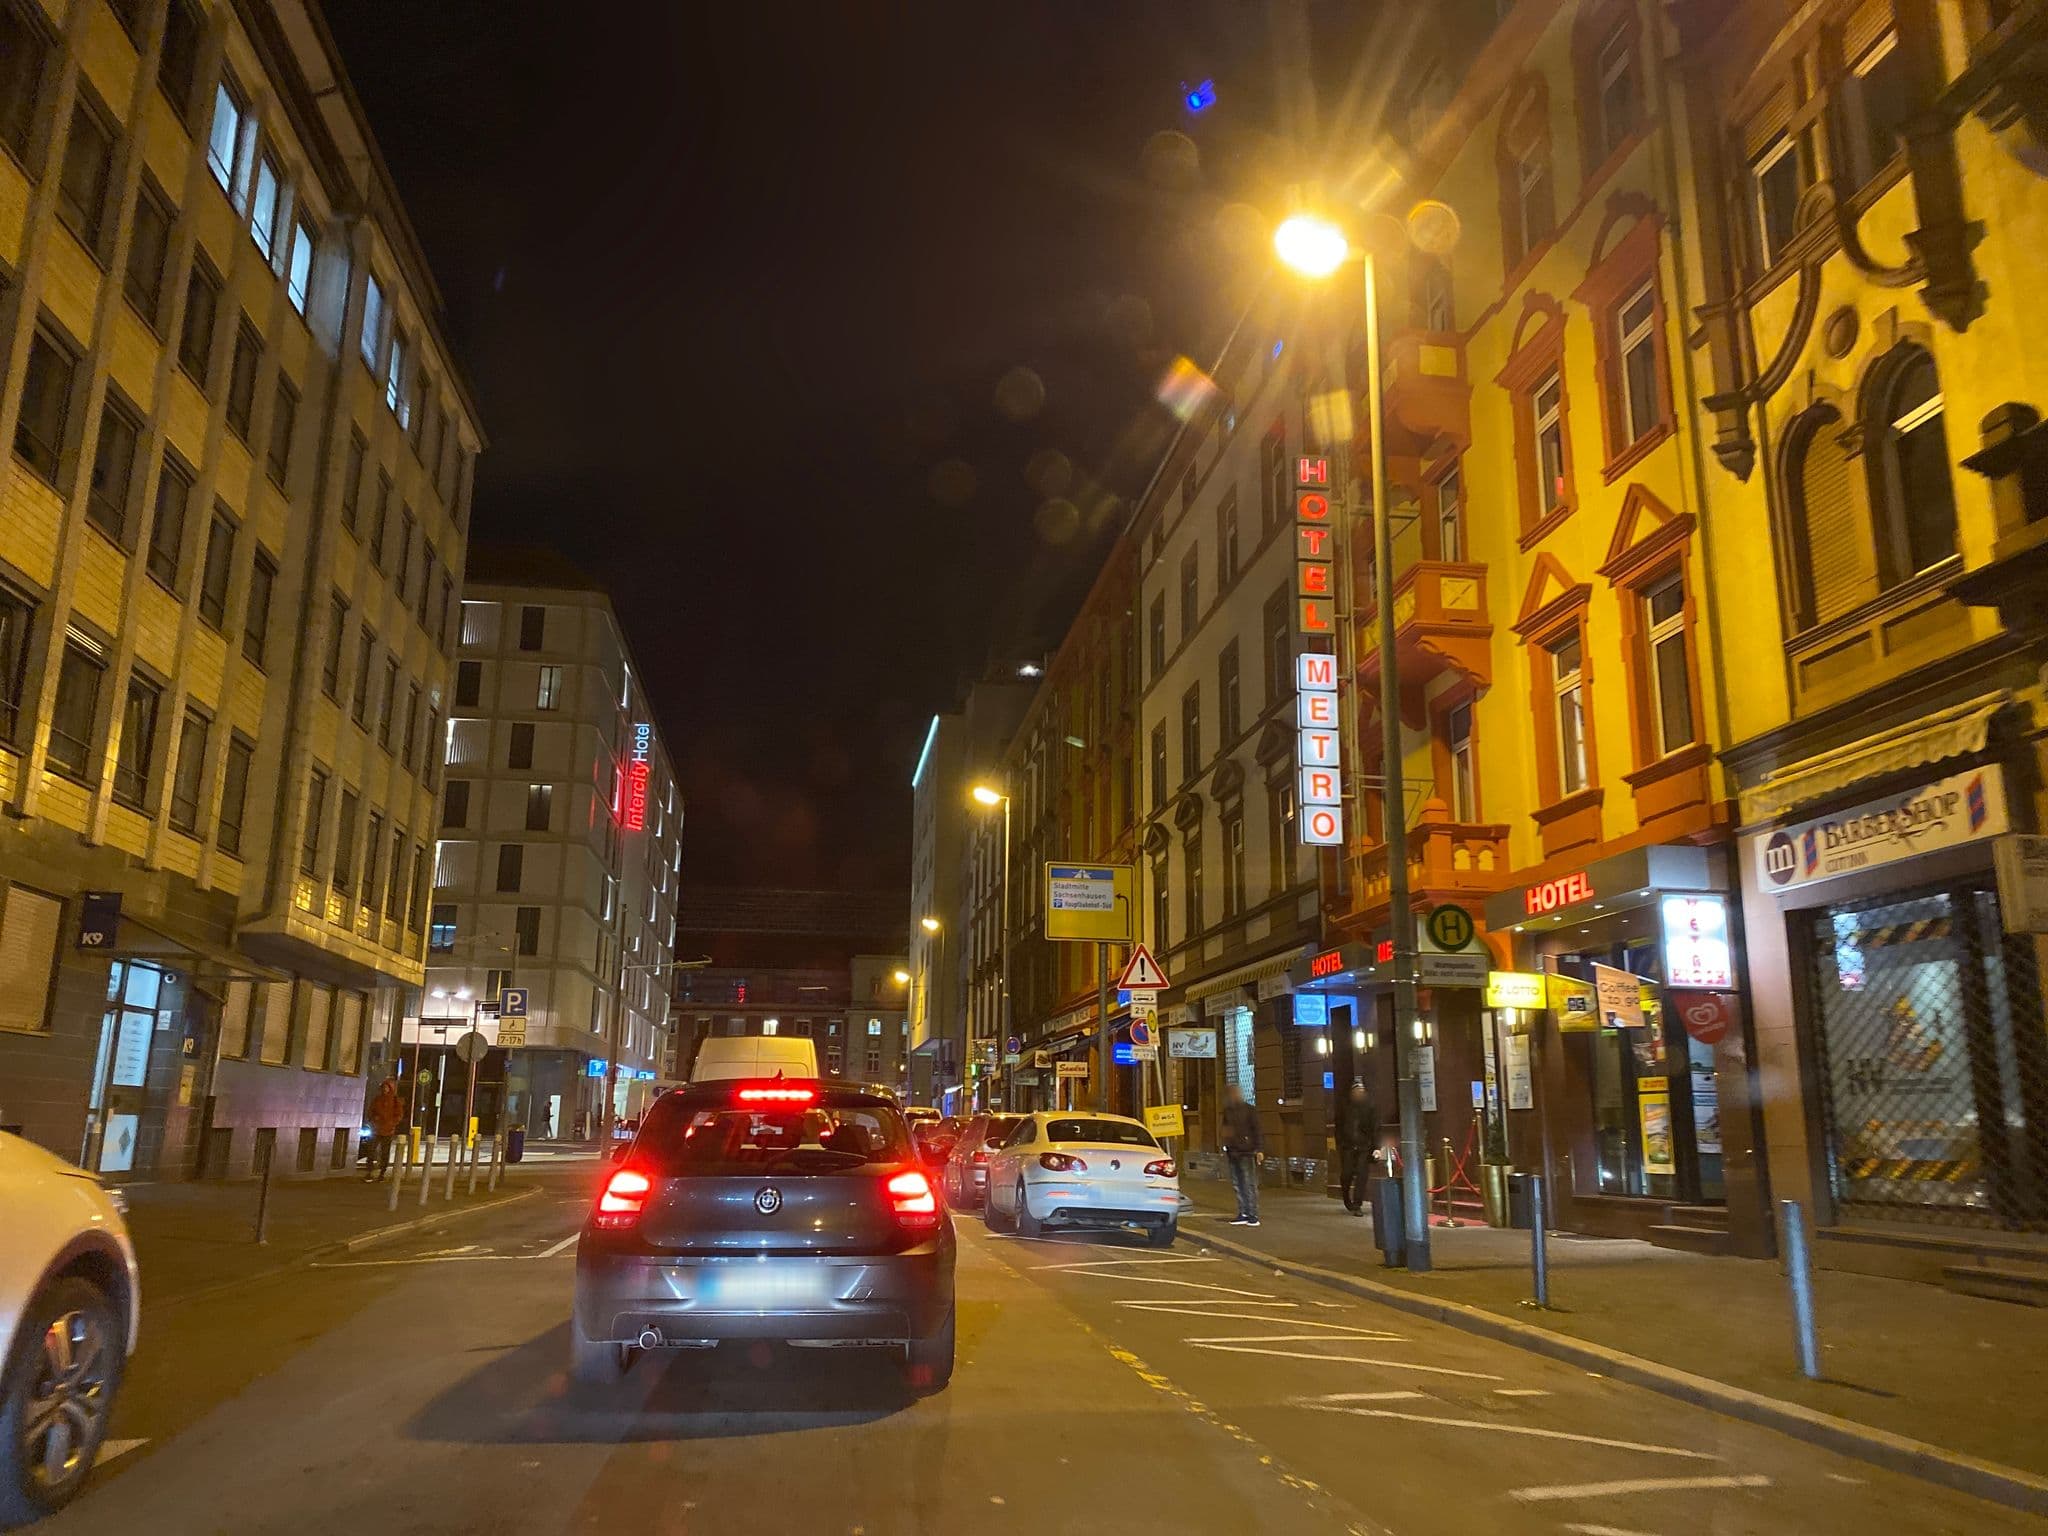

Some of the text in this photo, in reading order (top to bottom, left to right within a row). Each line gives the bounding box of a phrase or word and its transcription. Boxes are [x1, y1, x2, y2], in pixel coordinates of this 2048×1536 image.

[1299, 458, 1329, 630] HOTEL
[1307, 658, 1337, 838] METRO
[1526, 871, 1594, 915] HOTEL
[82, 931, 104, 946] K9
[1441, 915, 1460, 941] H
[1311, 952, 1344, 977] HOTEL
[1507, 984, 1540, 996] LOTTO
[1599, 981, 1639, 994] Coffee
[506, 992, 522, 1014] P
[1625, 996, 1640, 1008] go
